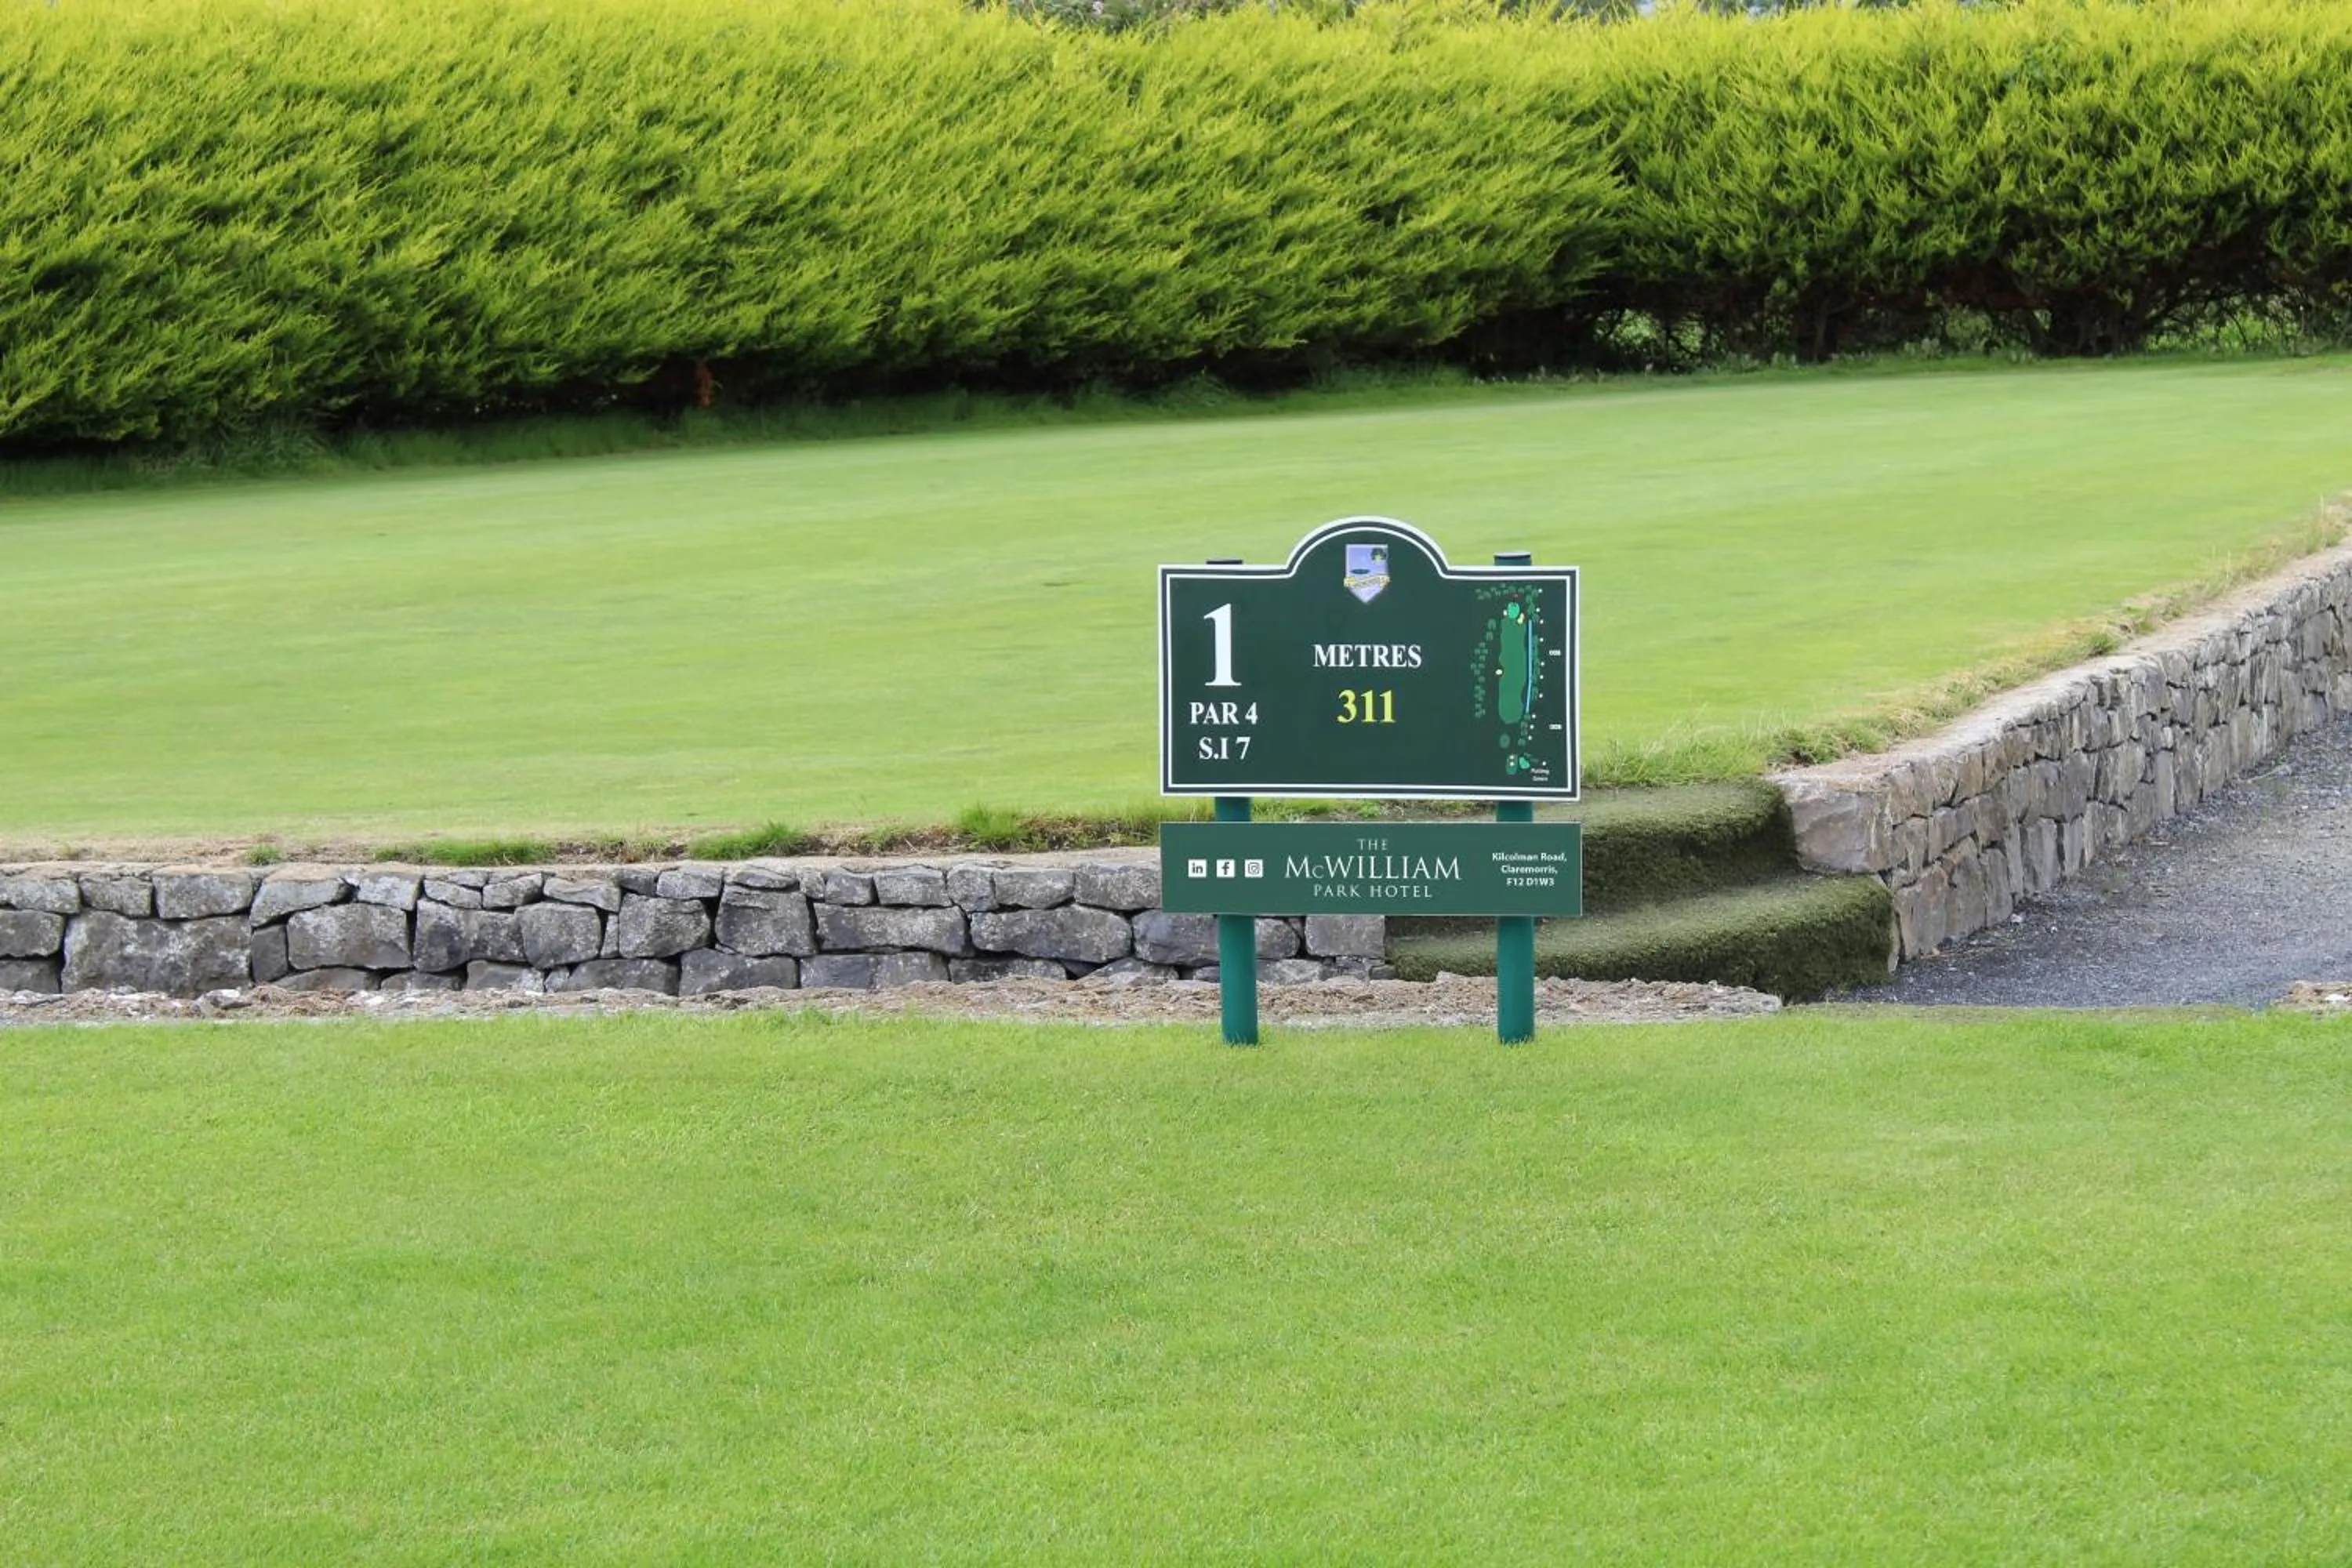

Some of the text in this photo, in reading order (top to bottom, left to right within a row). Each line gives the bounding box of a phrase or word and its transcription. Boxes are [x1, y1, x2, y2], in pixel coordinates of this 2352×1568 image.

[1203, 603, 1242, 687] 1
[1313, 644, 1422, 669] METRES
[1190, 702, 1258, 725] PAR 4
[1337, 689, 1395, 724] 311
[1199, 736, 1251, 760] S.I 7
[1357, 838, 1388, 851] THE
[1284, 855, 1461, 880] McWILLIAM
[1492, 852, 1567, 862] Kilcolman Road,
[1501, 865, 1558, 874] Claremorris,
[1313, 884, 1433, 898] PARK HOTEL
[1506, 877, 1555, 887] F12 D1W3
